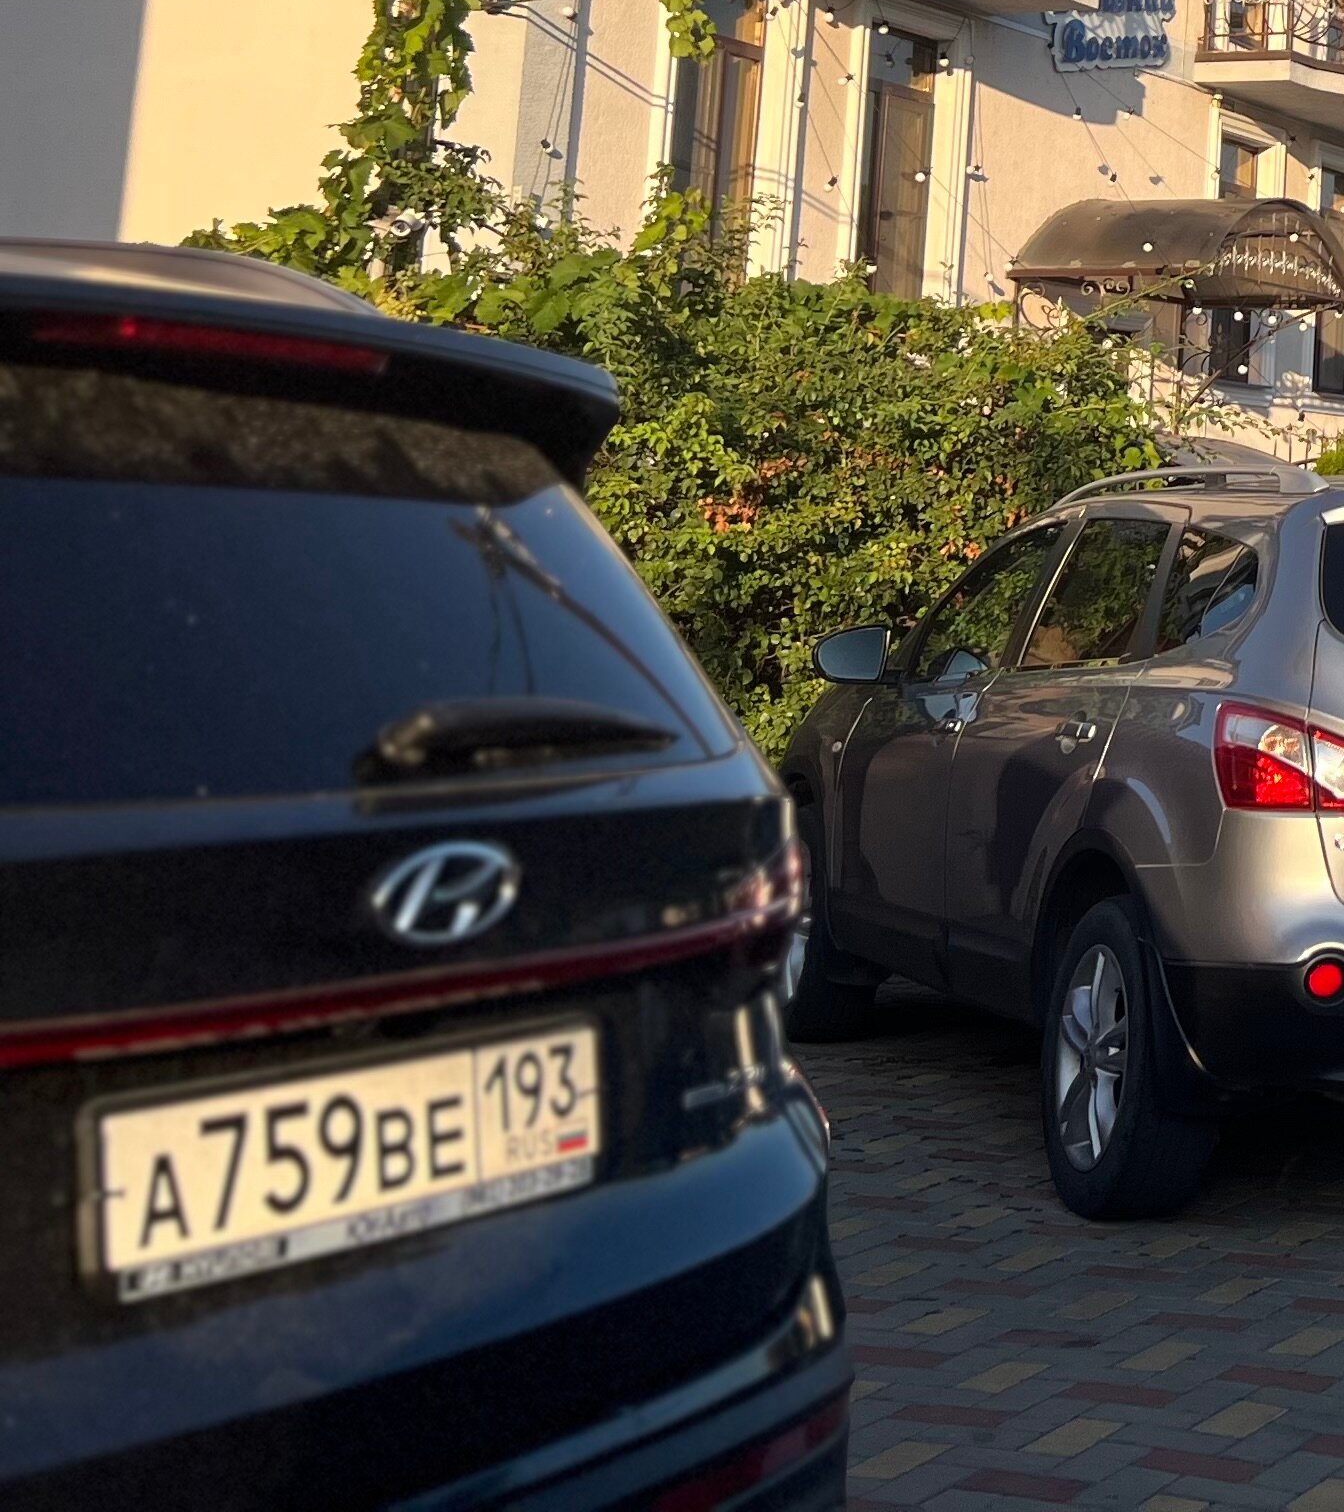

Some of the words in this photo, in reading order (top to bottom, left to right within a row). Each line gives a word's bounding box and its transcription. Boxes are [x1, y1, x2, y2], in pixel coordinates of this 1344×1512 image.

[1062, 18, 1168, 63] Восток
[484, 1043, 578, 1132] 193
[505, 1131, 557, 1162] RUS
